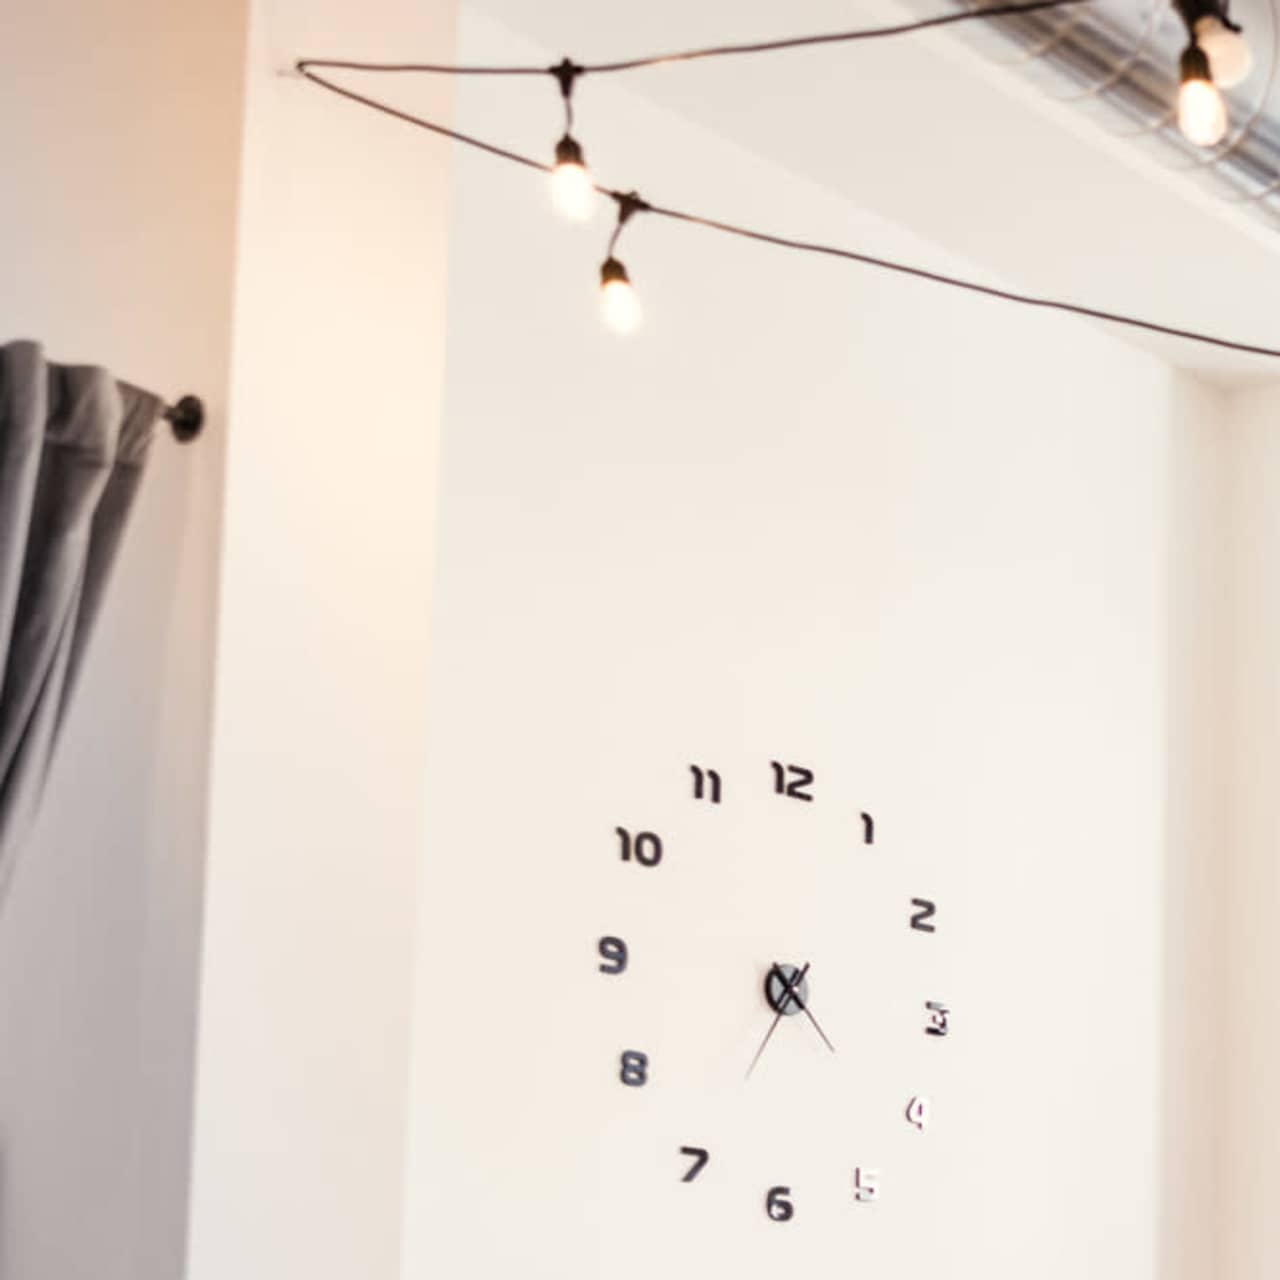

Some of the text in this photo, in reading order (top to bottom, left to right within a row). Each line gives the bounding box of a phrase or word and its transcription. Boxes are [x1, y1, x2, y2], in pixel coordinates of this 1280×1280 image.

[688, 763, 722, 805] 11
[769, 760, 815, 803] 12
[614, 825, 664, 869] 10
[859, 810, 875, 846] 1
[909, 897, 937, 934] 2
[597, 935, 629, 976] 9
[618, 1049, 650, 1088] 8
[679, 1145, 710, 1184] 7
[764, 1185, 796, 1223] 6
